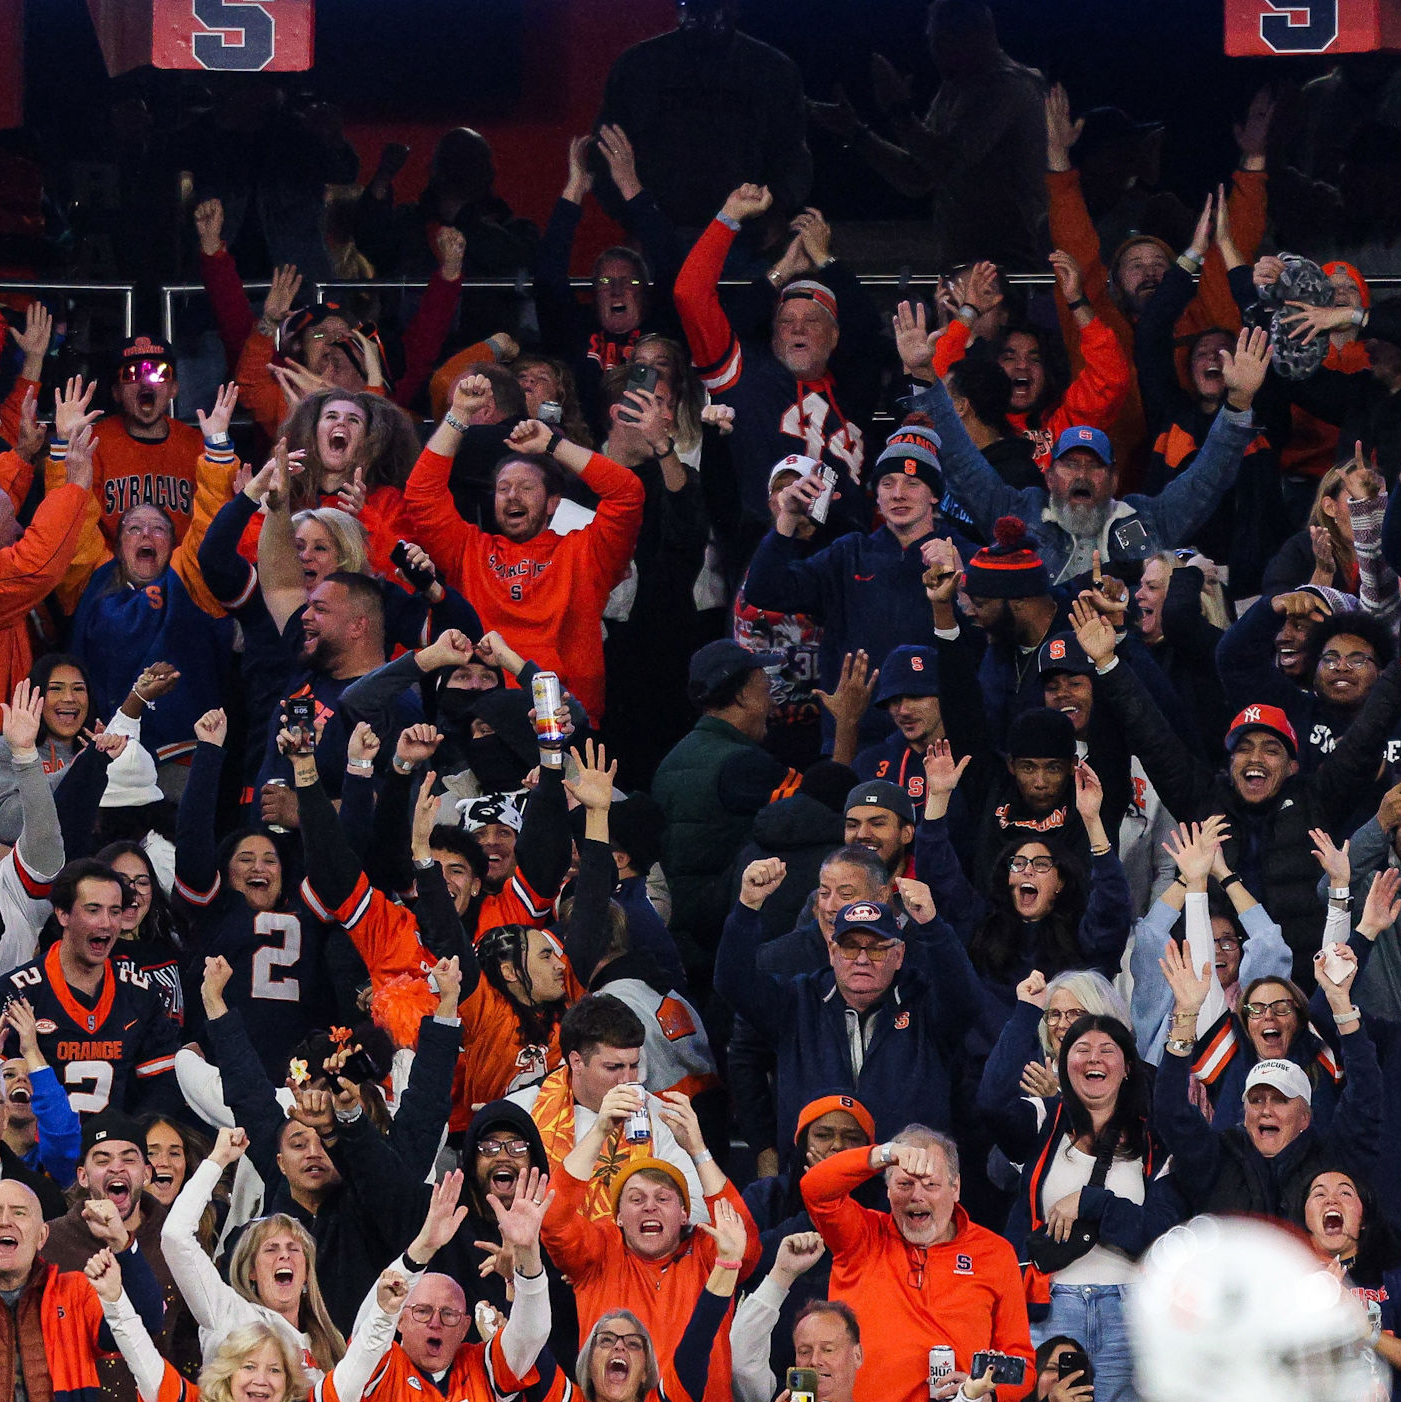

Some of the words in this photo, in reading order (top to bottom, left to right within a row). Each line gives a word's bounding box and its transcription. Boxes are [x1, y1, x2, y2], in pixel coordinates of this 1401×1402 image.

[192, 0, 275, 71] S
[1259, 0, 1338, 53] S
[904, 459, 917, 476] S
[103, 475, 193, 515] SYRACUS
[510, 584, 523, 602] S
[1050, 639, 1066, 660] S
[910, 656, 924, 672] S
[1244, 706, 1262, 723] NY
[876, 759, 891, 778] 3
[907, 776, 924, 798] S
[251, 910, 302, 1003] 2
[893, 1011, 911, 1030] S
[56, 1040, 123, 1063] ORANGE
[1253, 1060, 1291, 1073] SYRACUSE
[63, 1060, 115, 1115] 2
[955, 1253, 973, 1271] S
